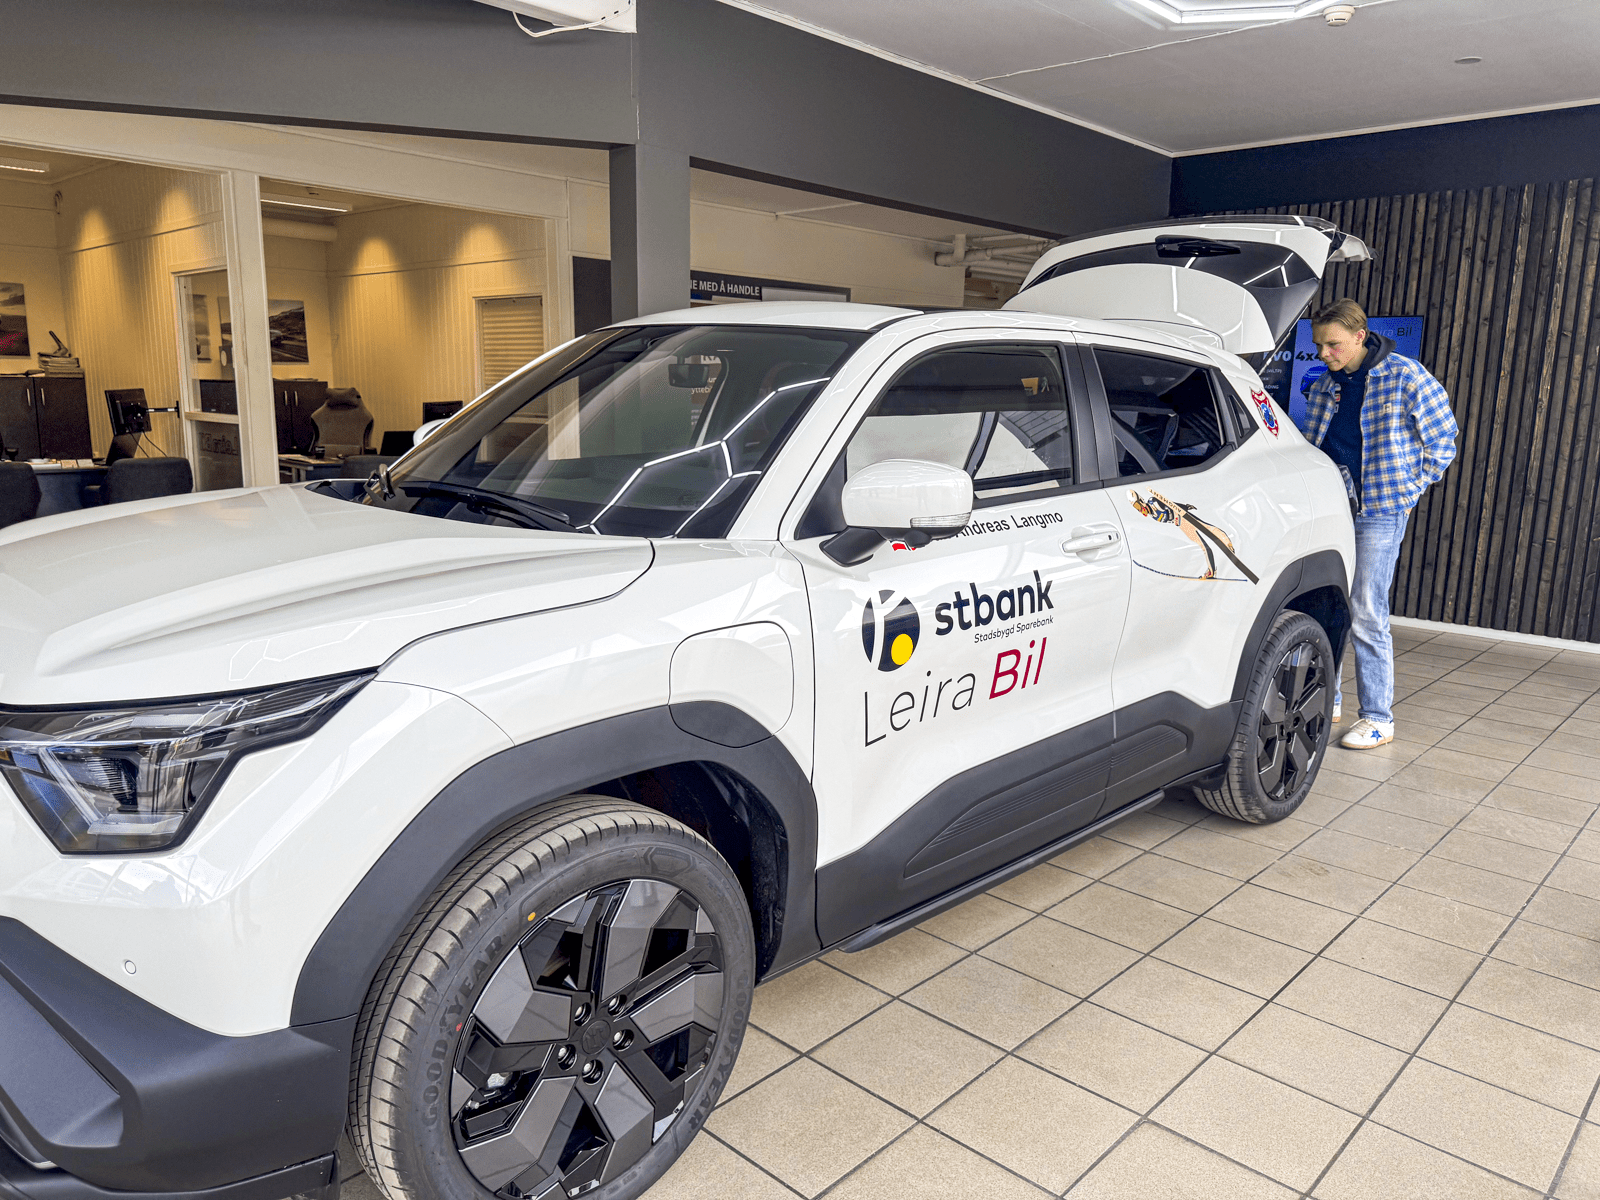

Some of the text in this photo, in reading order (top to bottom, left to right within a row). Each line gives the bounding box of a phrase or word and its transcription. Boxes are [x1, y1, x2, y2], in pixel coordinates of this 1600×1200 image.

[699, 280, 718, 292] MED
[719, 279, 726, 293] Å
[727, 283, 760, 296] HANDLE
[1397, 326, 1413, 337] Bil
[1010, 511, 1064, 529] Langmo
[934, 569, 1055, 637] stbank
[973, 615, 1055, 644] Stadsbygd Sparebank
[864, 636, 1048, 748] Leira Bil
[420, 934, 504, 1128] GOODYEAR
